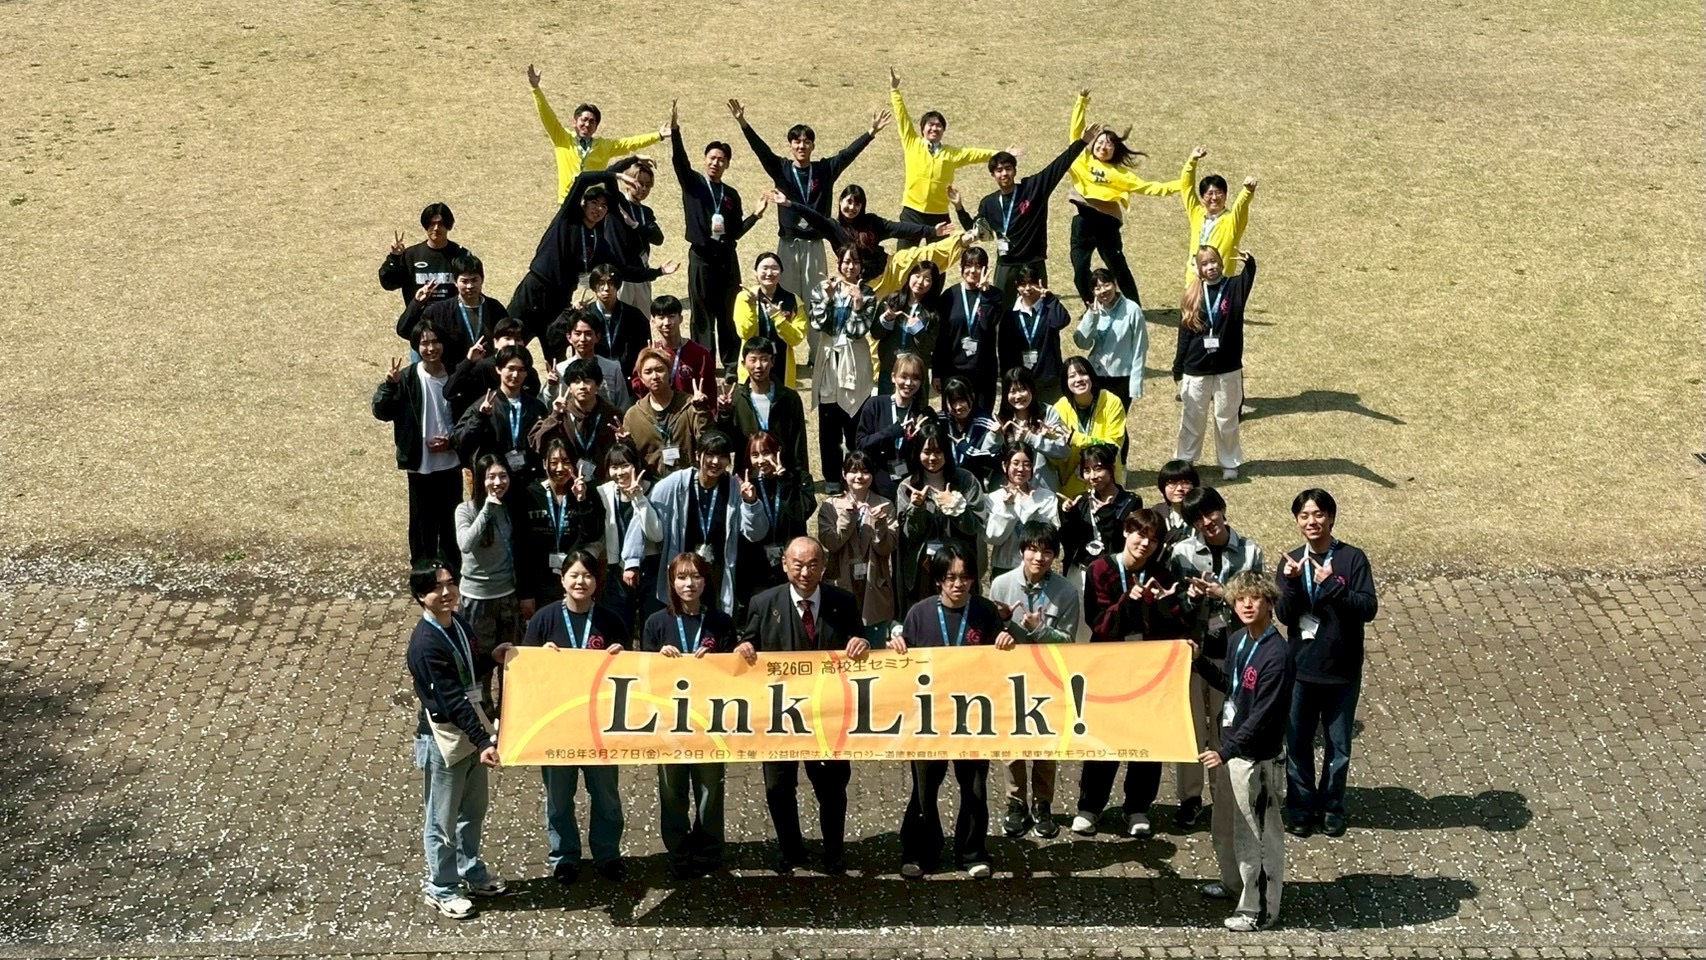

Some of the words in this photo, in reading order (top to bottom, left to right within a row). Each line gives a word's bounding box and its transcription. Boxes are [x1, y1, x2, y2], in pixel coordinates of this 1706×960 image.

[767, 661, 812, 676] 第26回
[821, 657, 929, 674] 高校生セミナー
[603, 676, 813, 734] Link
[848, 674, 1086, 735] Link!
